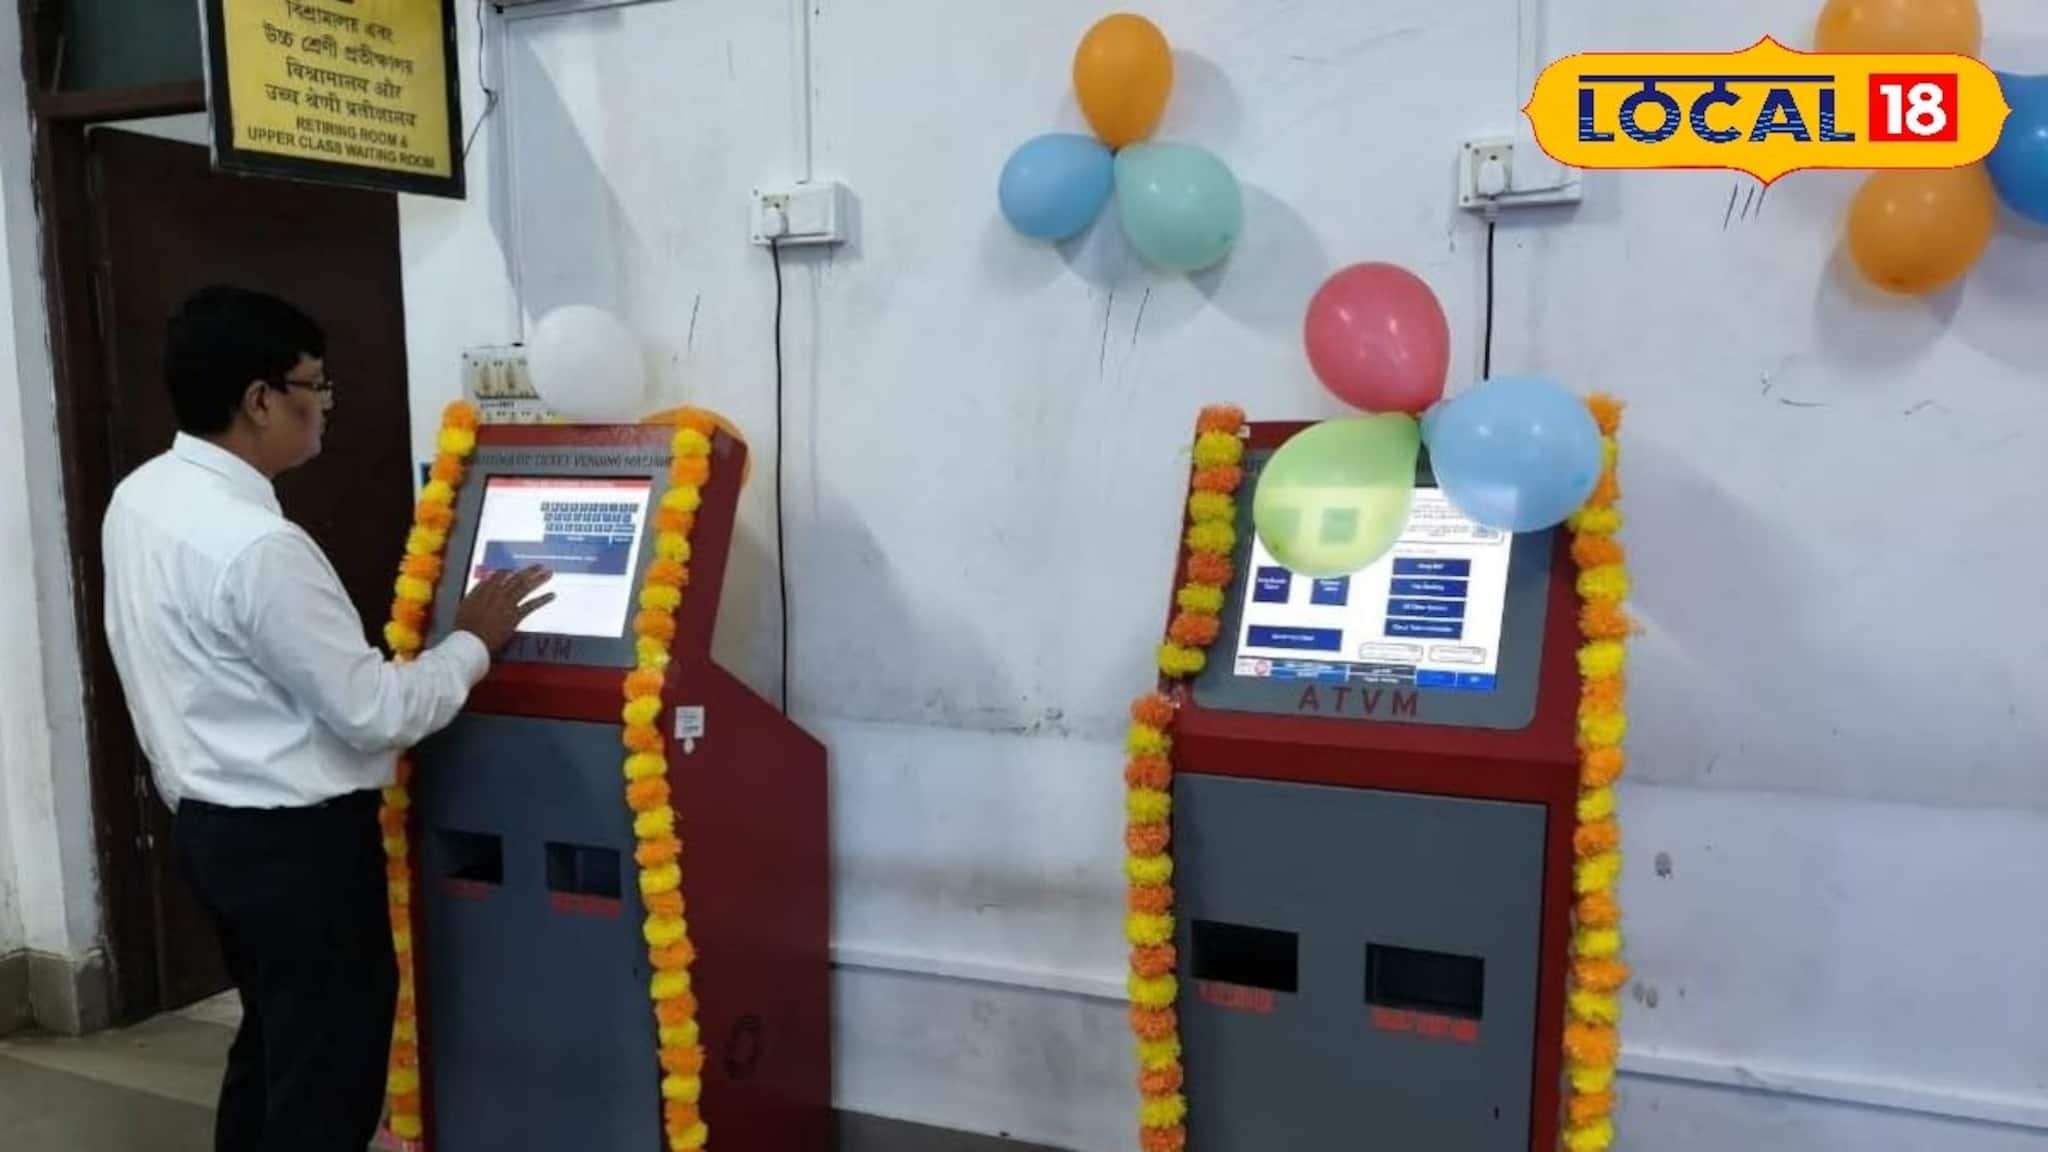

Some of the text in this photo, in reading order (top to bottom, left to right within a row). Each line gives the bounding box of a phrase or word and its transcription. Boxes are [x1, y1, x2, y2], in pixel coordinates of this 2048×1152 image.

[296, 116, 357, 140] RETIRING
[360, 124, 397, 146] ROOM
[248, 126, 435, 169] UPPER CLASS WAITING ROOM
[1298, 684, 1419, 716] ATVM
